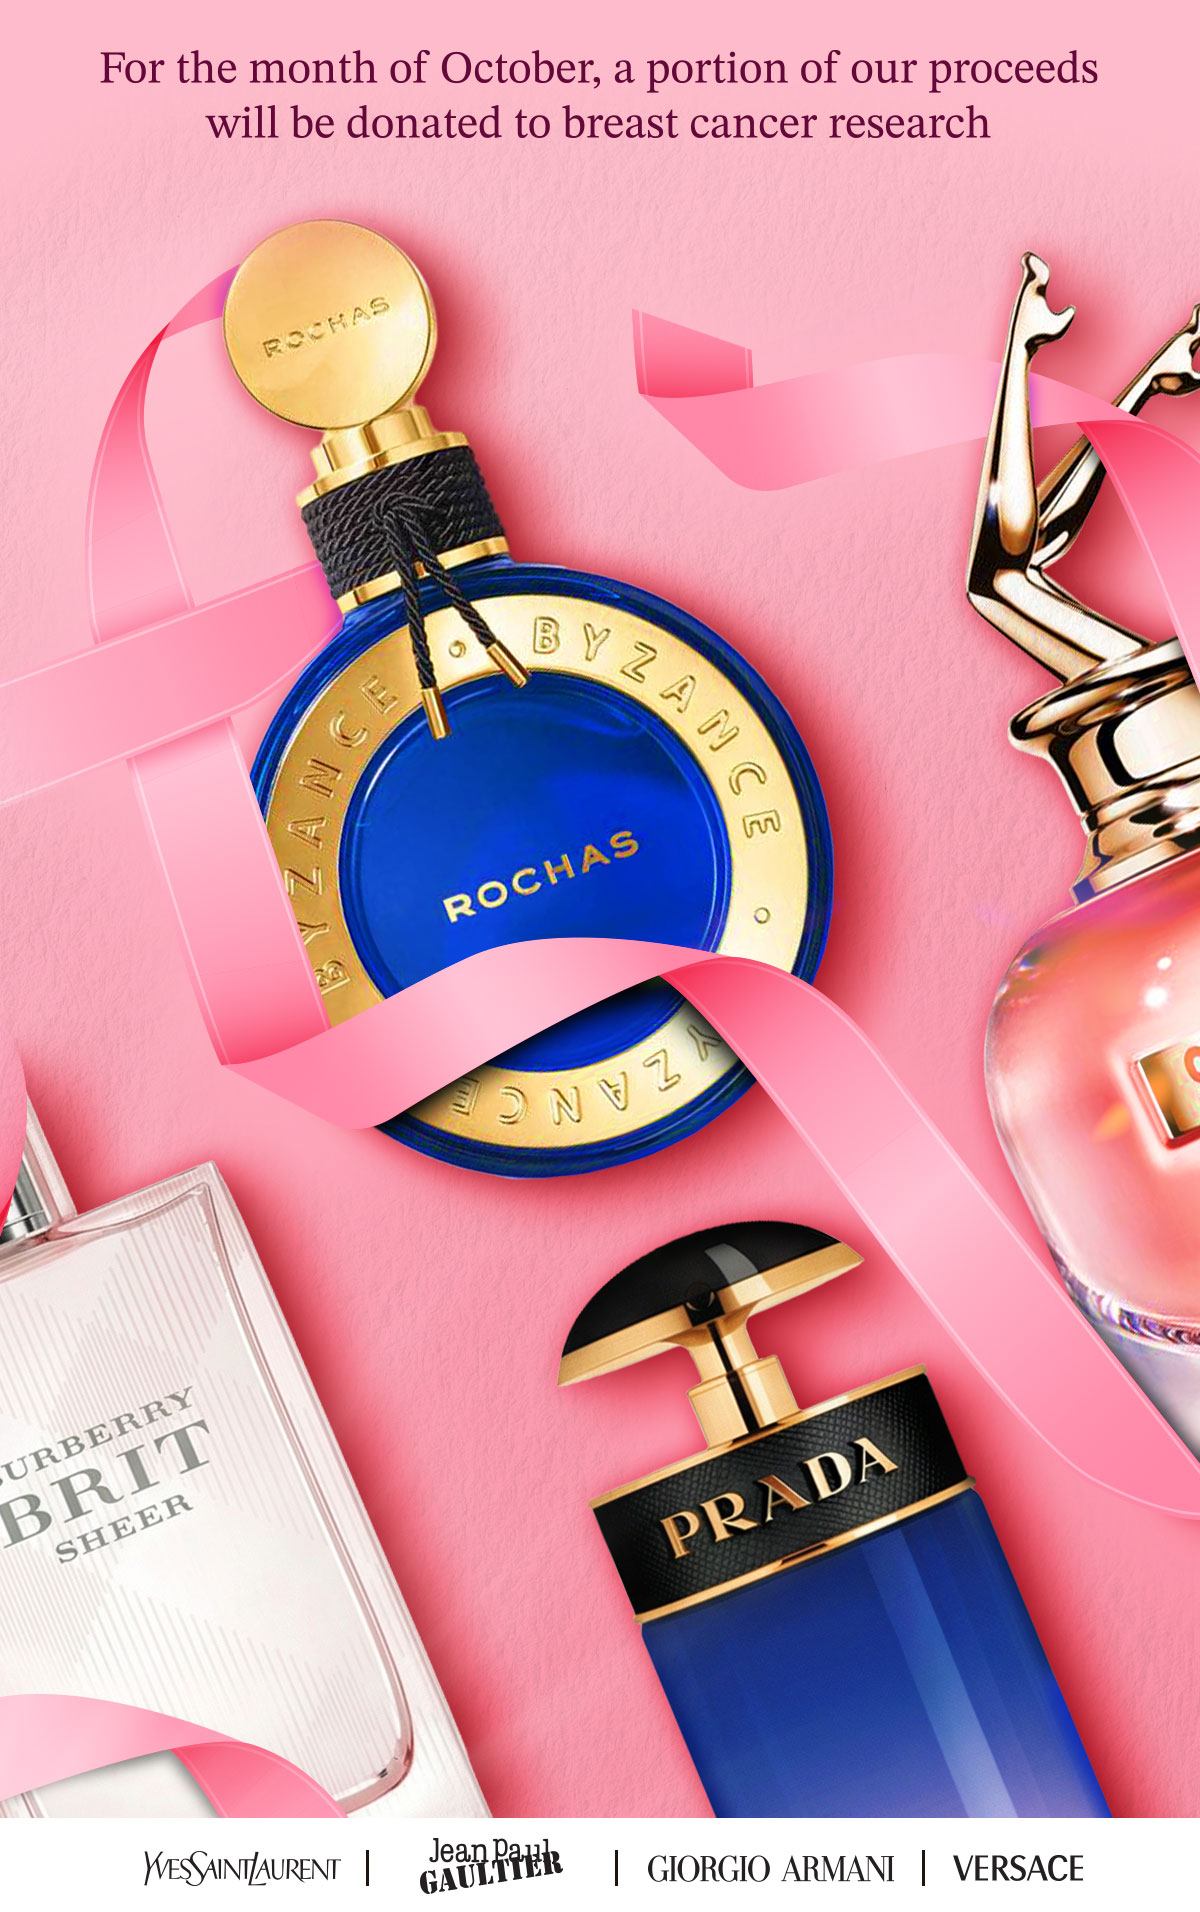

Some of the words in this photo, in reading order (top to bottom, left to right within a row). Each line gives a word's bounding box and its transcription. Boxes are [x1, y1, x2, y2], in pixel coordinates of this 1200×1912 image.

[262, 297, 390, 359] ROCHAS
[532, 616, 782, 838] BYZANCE
[443, 830, 639, 924] ROCHAS
[451, 1022, 722, 1126] YZANCE
[0, 1385, 193, 1487] URBERRY
[0, 1419, 210, 1549] BRIT
[55, 1494, 194, 1564] SHEER
[660, 1437, 899, 1559] PRADA
